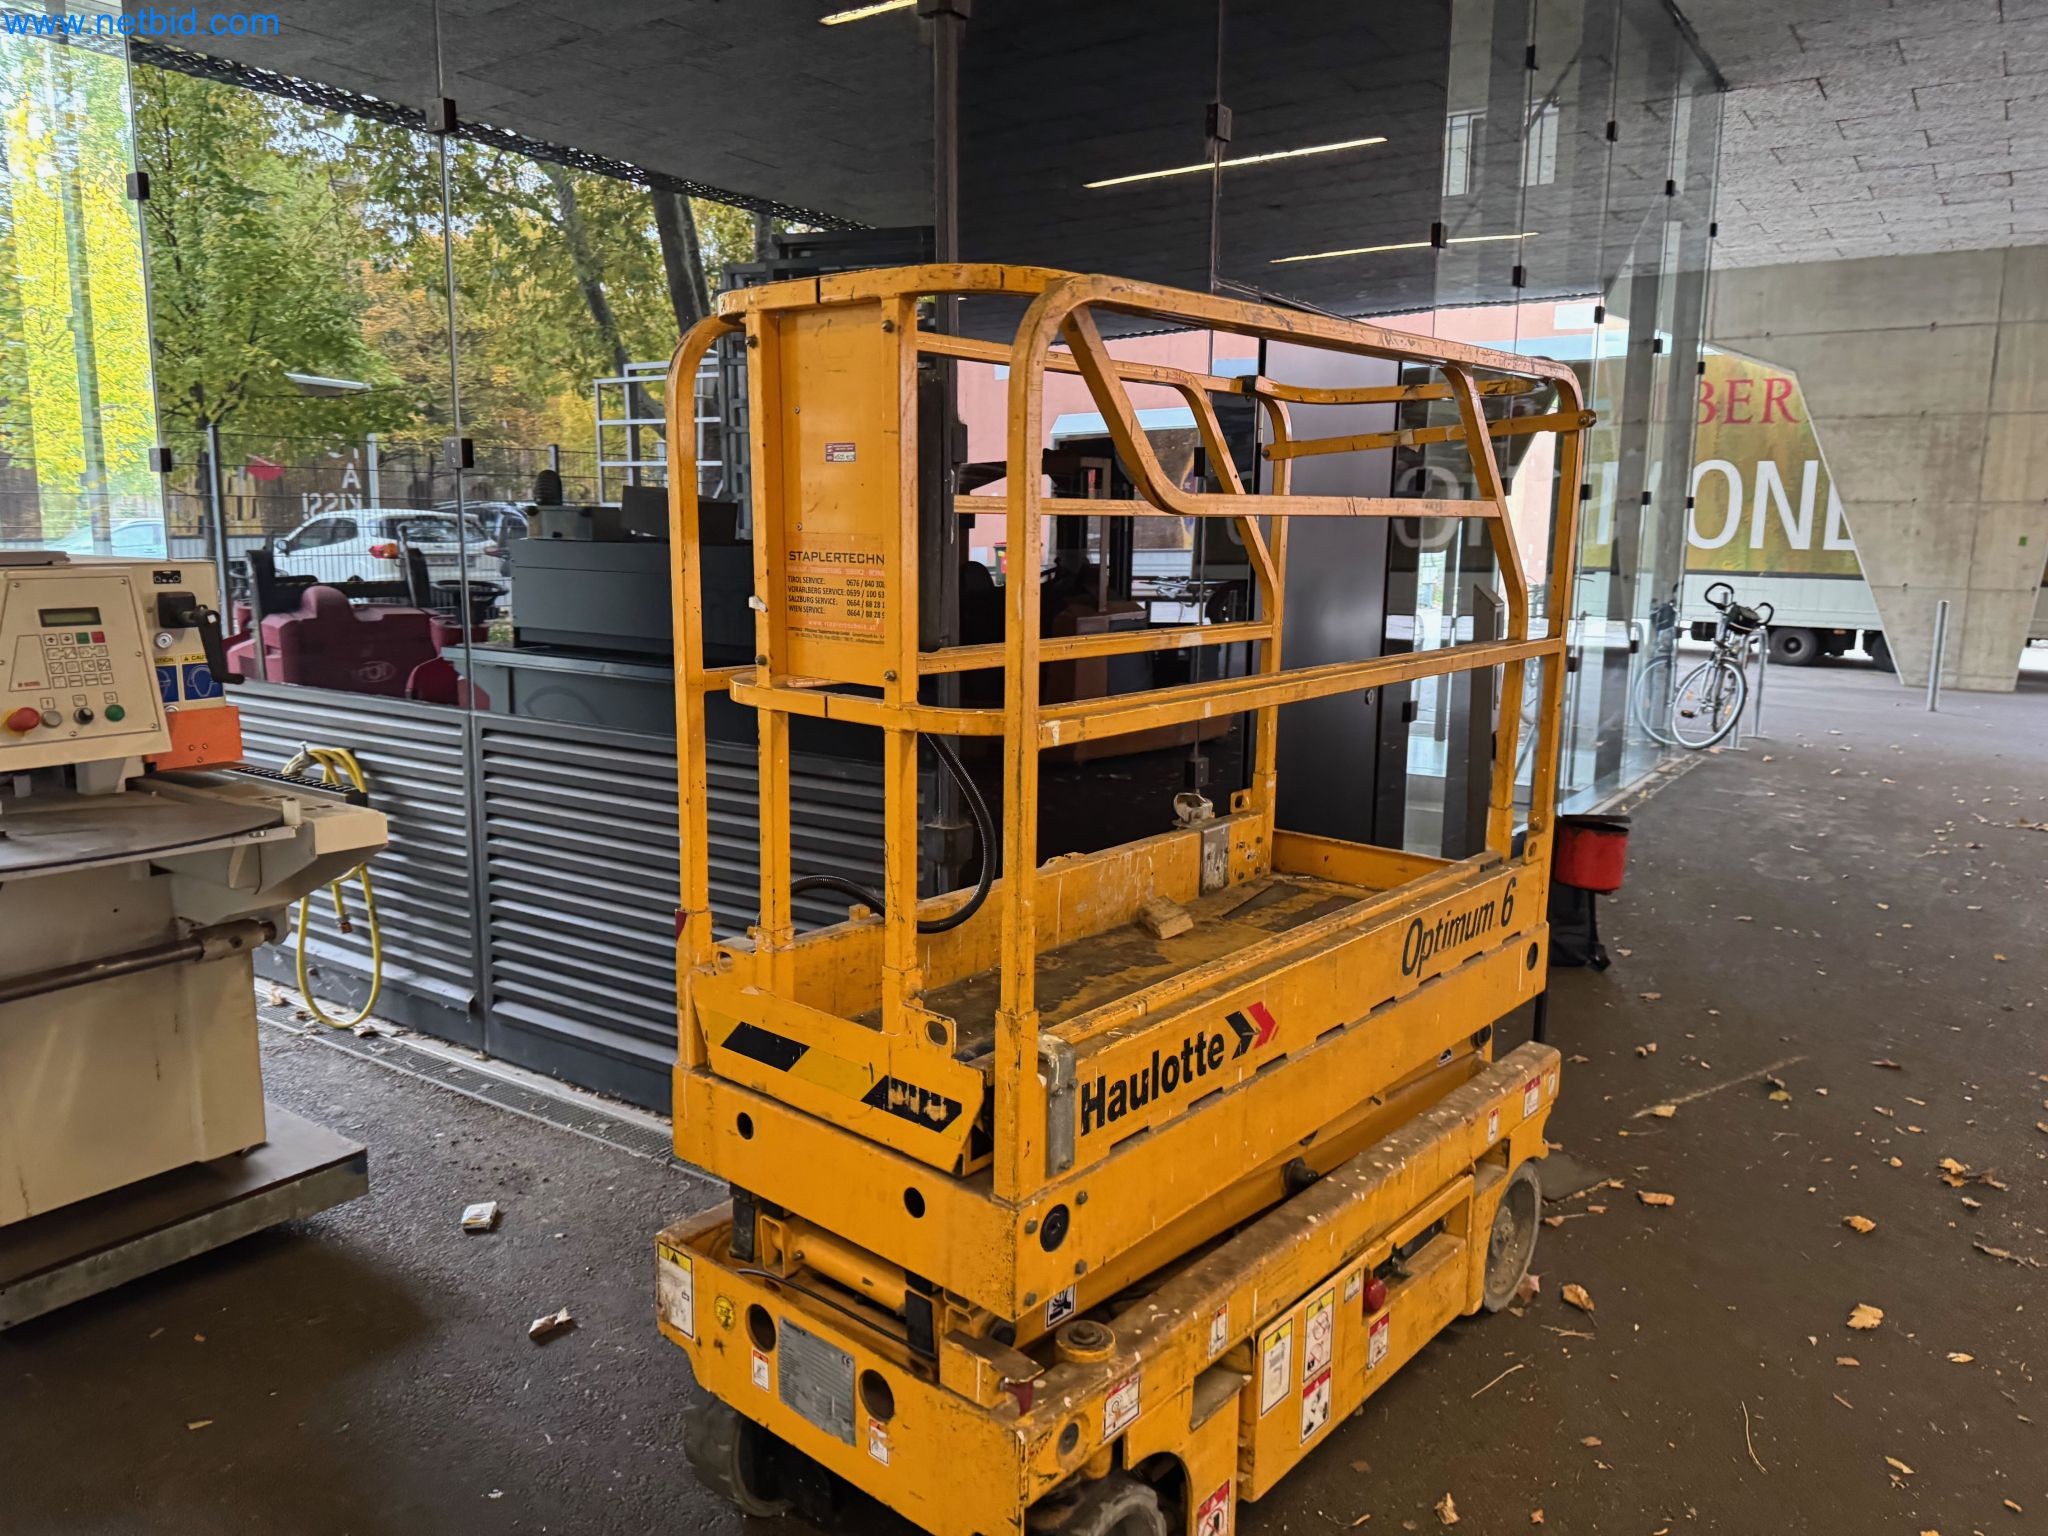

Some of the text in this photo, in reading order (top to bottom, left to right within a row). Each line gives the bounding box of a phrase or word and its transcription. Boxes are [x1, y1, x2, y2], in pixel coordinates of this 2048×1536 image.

[788, 551, 885, 566] STAPLERTECHN
[787, 585, 821, 594] VORARLBERG
[787, 595, 814, 603] SALZBURG
[788, 605, 802, 613] WIEN
[1402, 877, 1516, 978] Optimum 6
[1081, 1031, 1225, 1137] Haulotte
